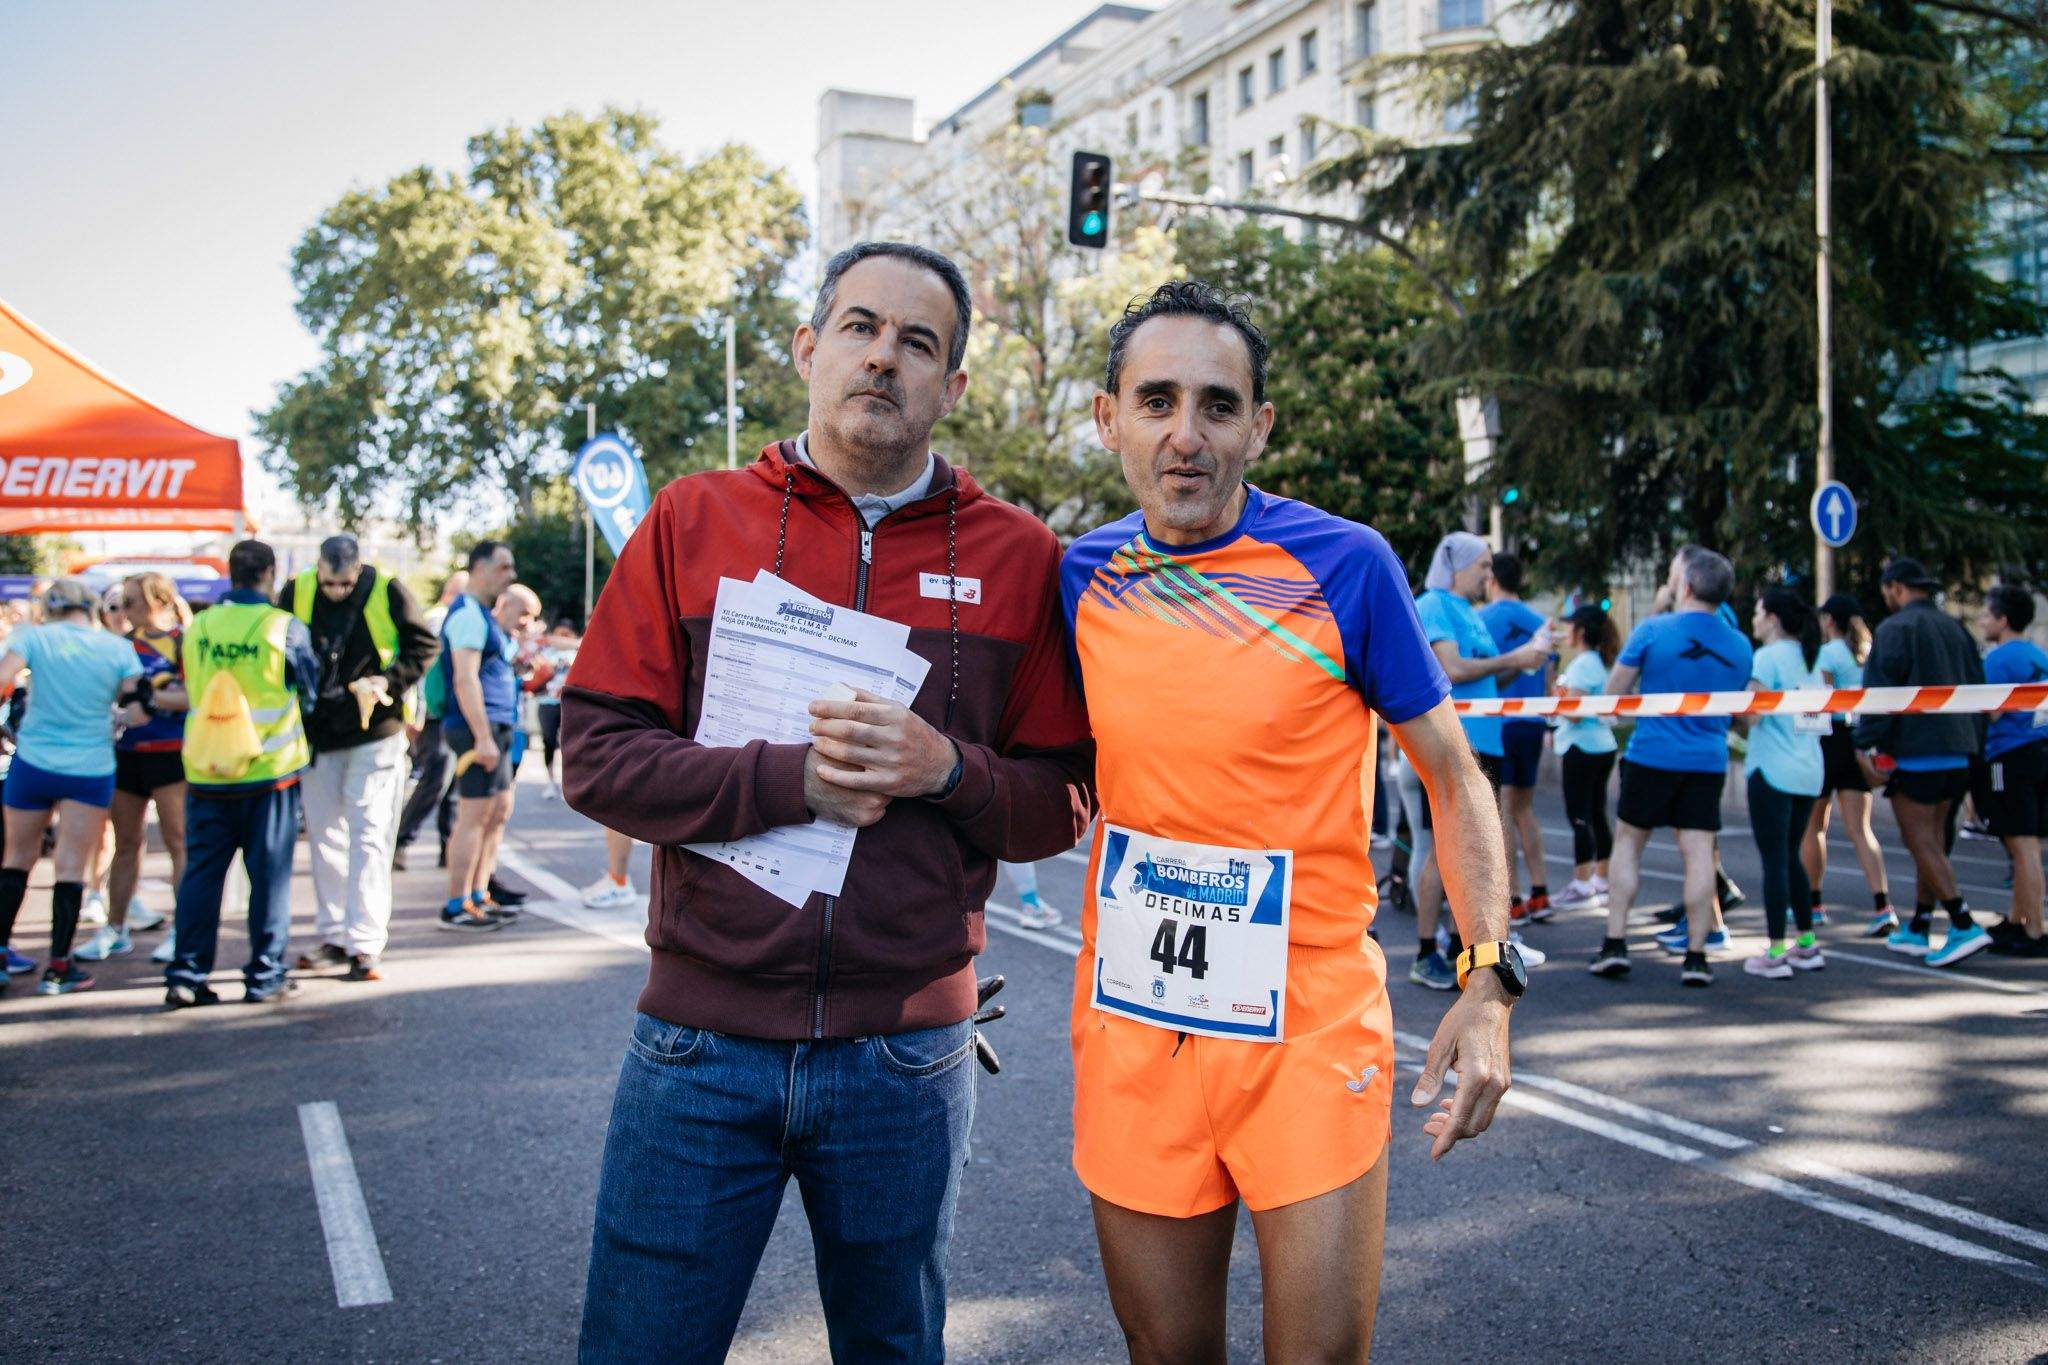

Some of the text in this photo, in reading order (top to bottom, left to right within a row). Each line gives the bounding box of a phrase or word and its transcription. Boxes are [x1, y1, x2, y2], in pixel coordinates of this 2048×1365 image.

[791, 603, 833, 619] BOMBEROS
[720, 616, 736, 626] HOJA
[736, 618, 747, 627] DE
[730, 610, 755, 621] Carrera
[755, 615, 788, 630] Bomberos
[789, 622, 798, 632] de
[798, 626, 823, 639] Madrid
[828, 634, 858, 648] DECIMAS
[783, 615, 828, 632] DECIMAS
[1156, 856, 1187, 867] CARRERA
[1156, 865, 1245, 889] BOMBEROS
[1186, 886, 1245, 904] de MADRID
[1145, 893, 1240, 923] DECIMAS
[1150, 917, 1209, 980] 44
